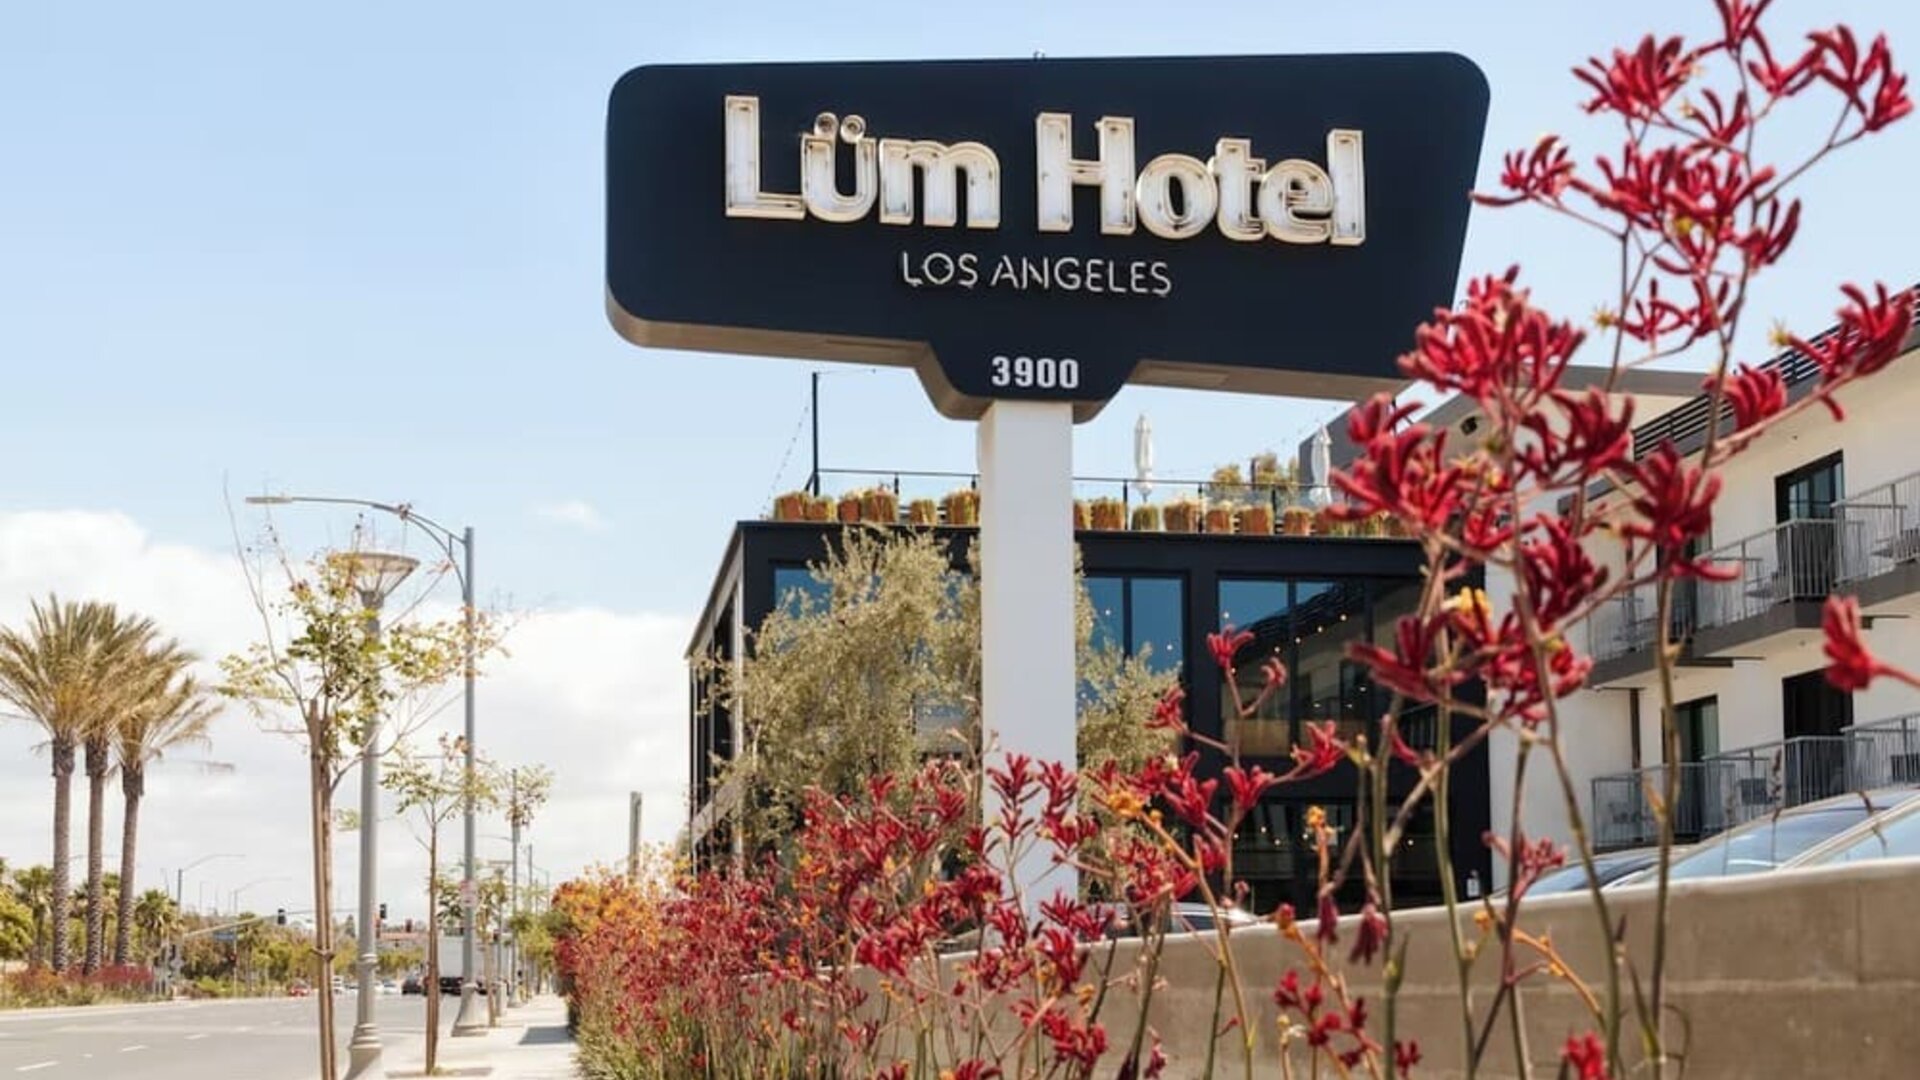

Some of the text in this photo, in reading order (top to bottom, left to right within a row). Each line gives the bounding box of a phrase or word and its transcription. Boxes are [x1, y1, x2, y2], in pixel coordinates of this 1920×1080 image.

[725, 95, 1366, 245] Lüm Hotel
[902, 251, 1172, 297] LOS ANGELES
[991, 356, 1080, 389] 3900
